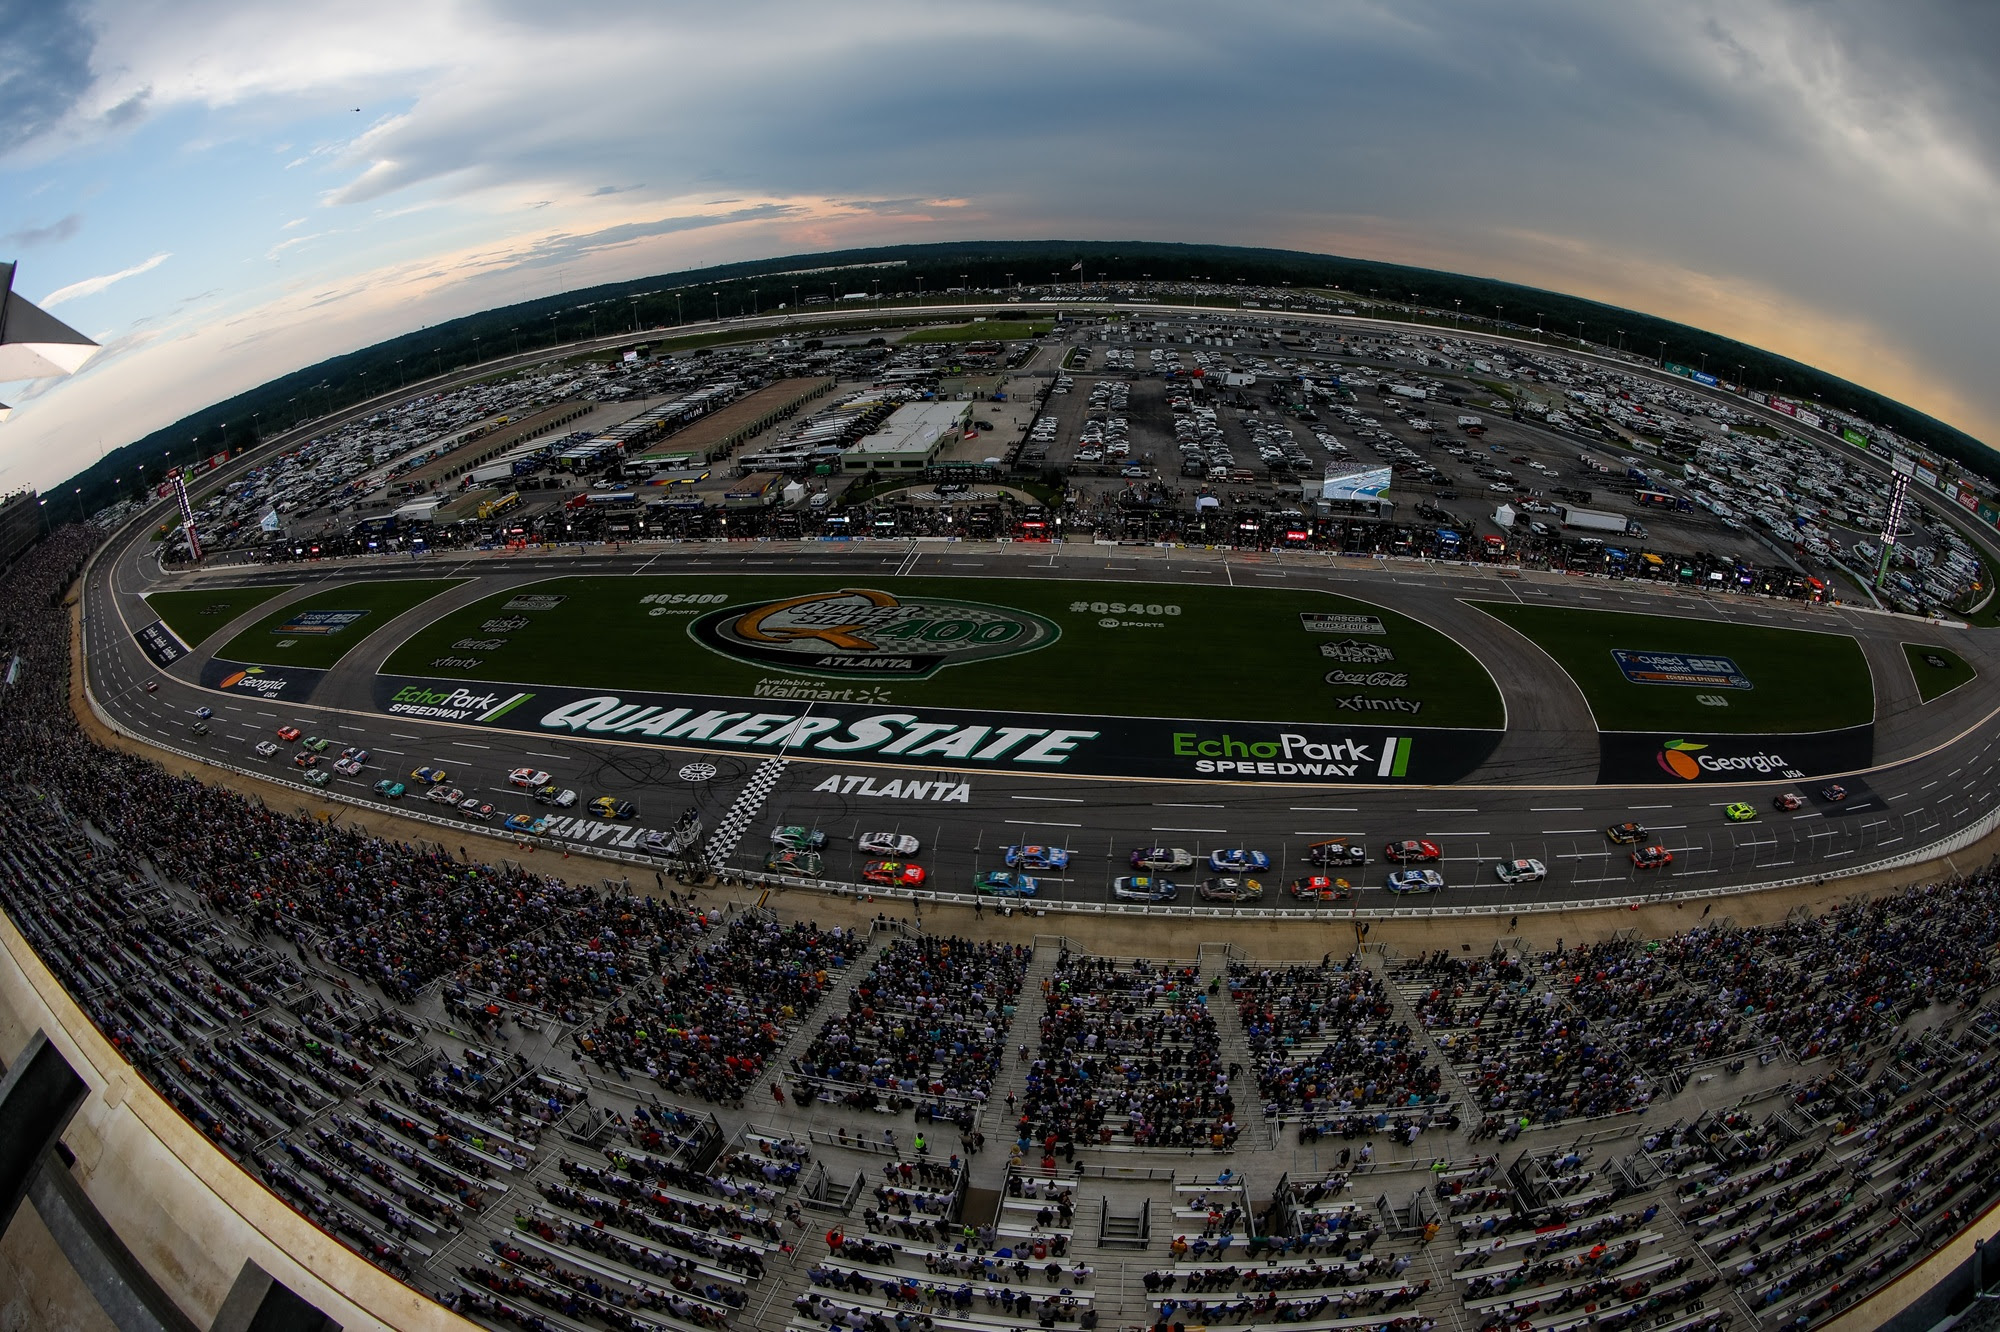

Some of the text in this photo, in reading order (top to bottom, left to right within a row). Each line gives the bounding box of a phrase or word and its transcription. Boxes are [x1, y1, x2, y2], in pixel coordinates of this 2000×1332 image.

[639, 593, 729, 604] #QS400
[790, 601, 924, 616] QUAKER
[1069, 601, 1182, 616] #QS400
[480, 618, 532, 630] BUSCH
[791, 613, 889, 627] STATE
[1326, 615, 1368, 623] NASCAR
[874, 619, 1025, 643] 400
[1319, 645, 1395, 662] BUSCH
[1616, 652, 1685, 666] Focused
[429, 655, 485, 670] xfinity
[817, 655, 914, 669] ATLANTA
[1654, 664, 1692, 674] Health
[237, 676, 288, 692] Georgia
[759, 677, 811, 688] Available
[1325, 669, 1409, 687] Coca-Cola
[263, 691, 279, 699] USA
[391, 685, 499, 711] EchoPark
[753, 684, 854, 701] Walmart
[388, 703, 473, 720] SPEEDWAY
[1335, 695, 1422, 714] xfinity
[540, 696, 1103, 765] QUAKER STATE
[1172, 732, 1375, 762] EchoPark
[1195, 759, 1359, 777] SPEEDWAY
[1697, 751, 1789, 773] Georgia
[1782, 769, 1806, 779] USA
[812, 774, 971, 803] ATLANTA
